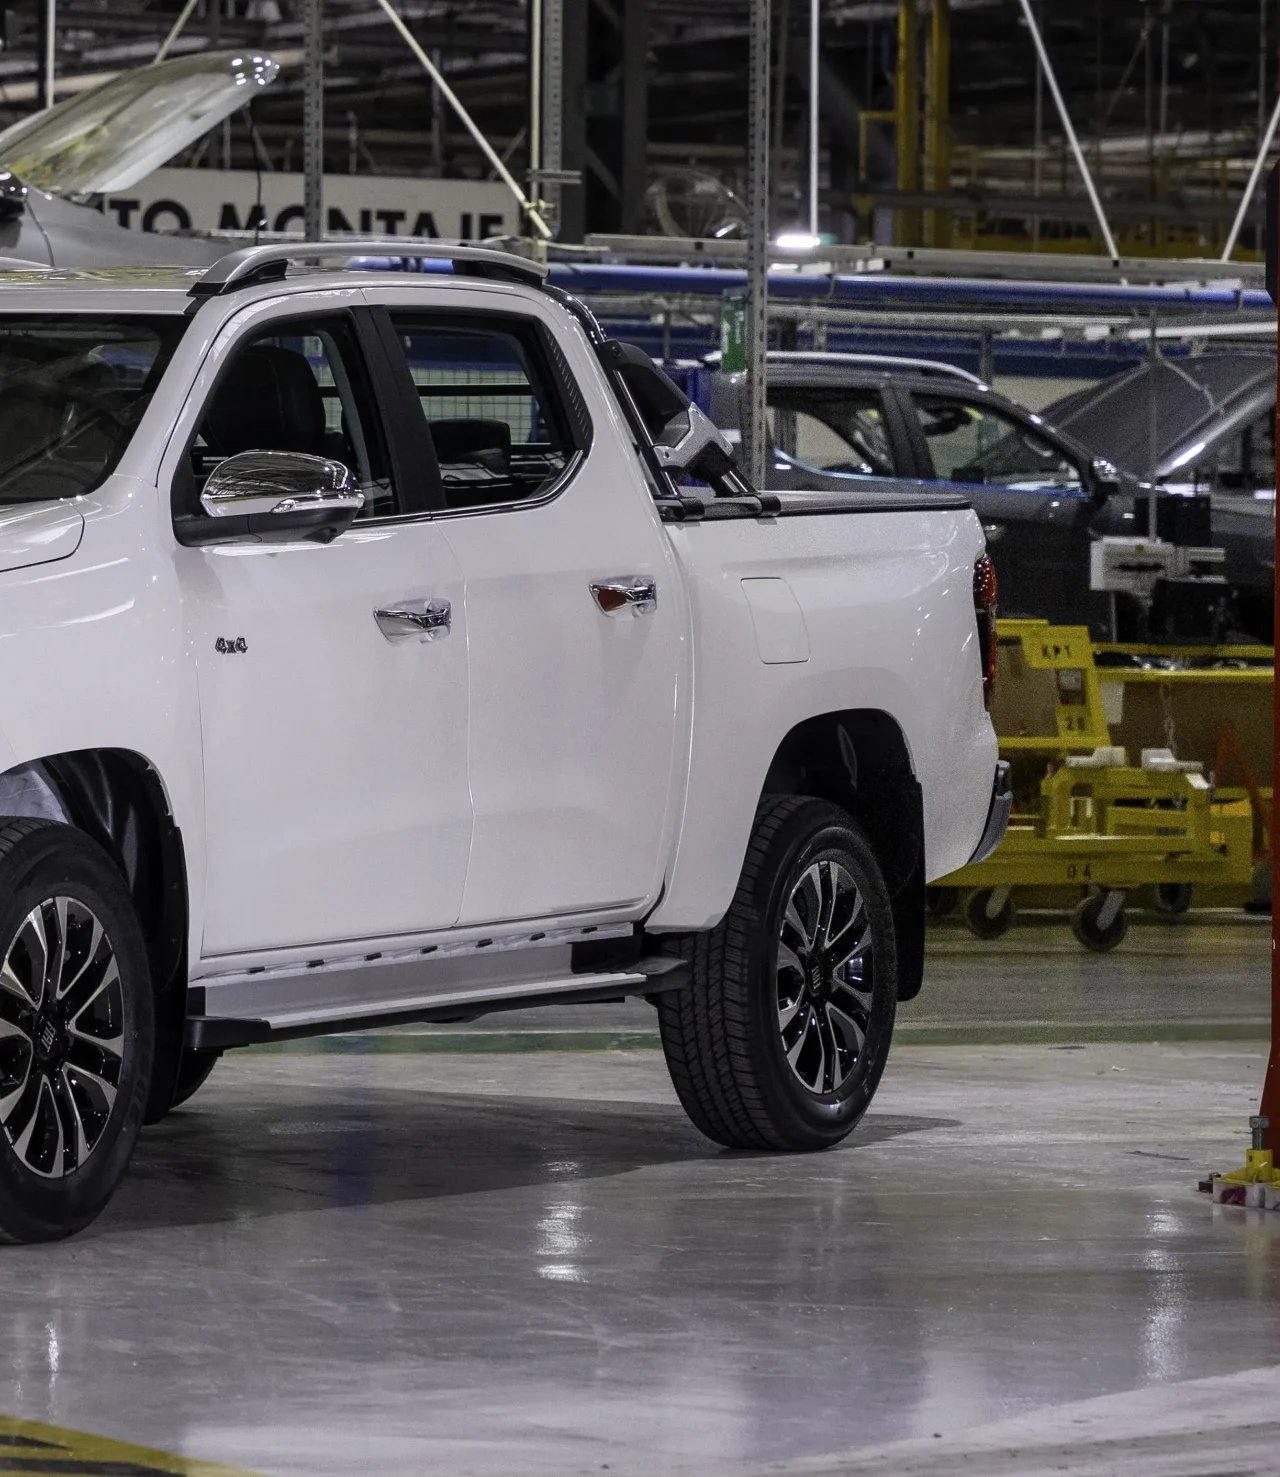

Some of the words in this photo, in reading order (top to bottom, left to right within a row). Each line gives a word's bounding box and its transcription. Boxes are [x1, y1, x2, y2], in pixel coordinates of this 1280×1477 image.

[92, 192, 190, 233] TO
[215, 636, 248, 654] 4x4
[41, 1020, 56, 1053] FIAT
